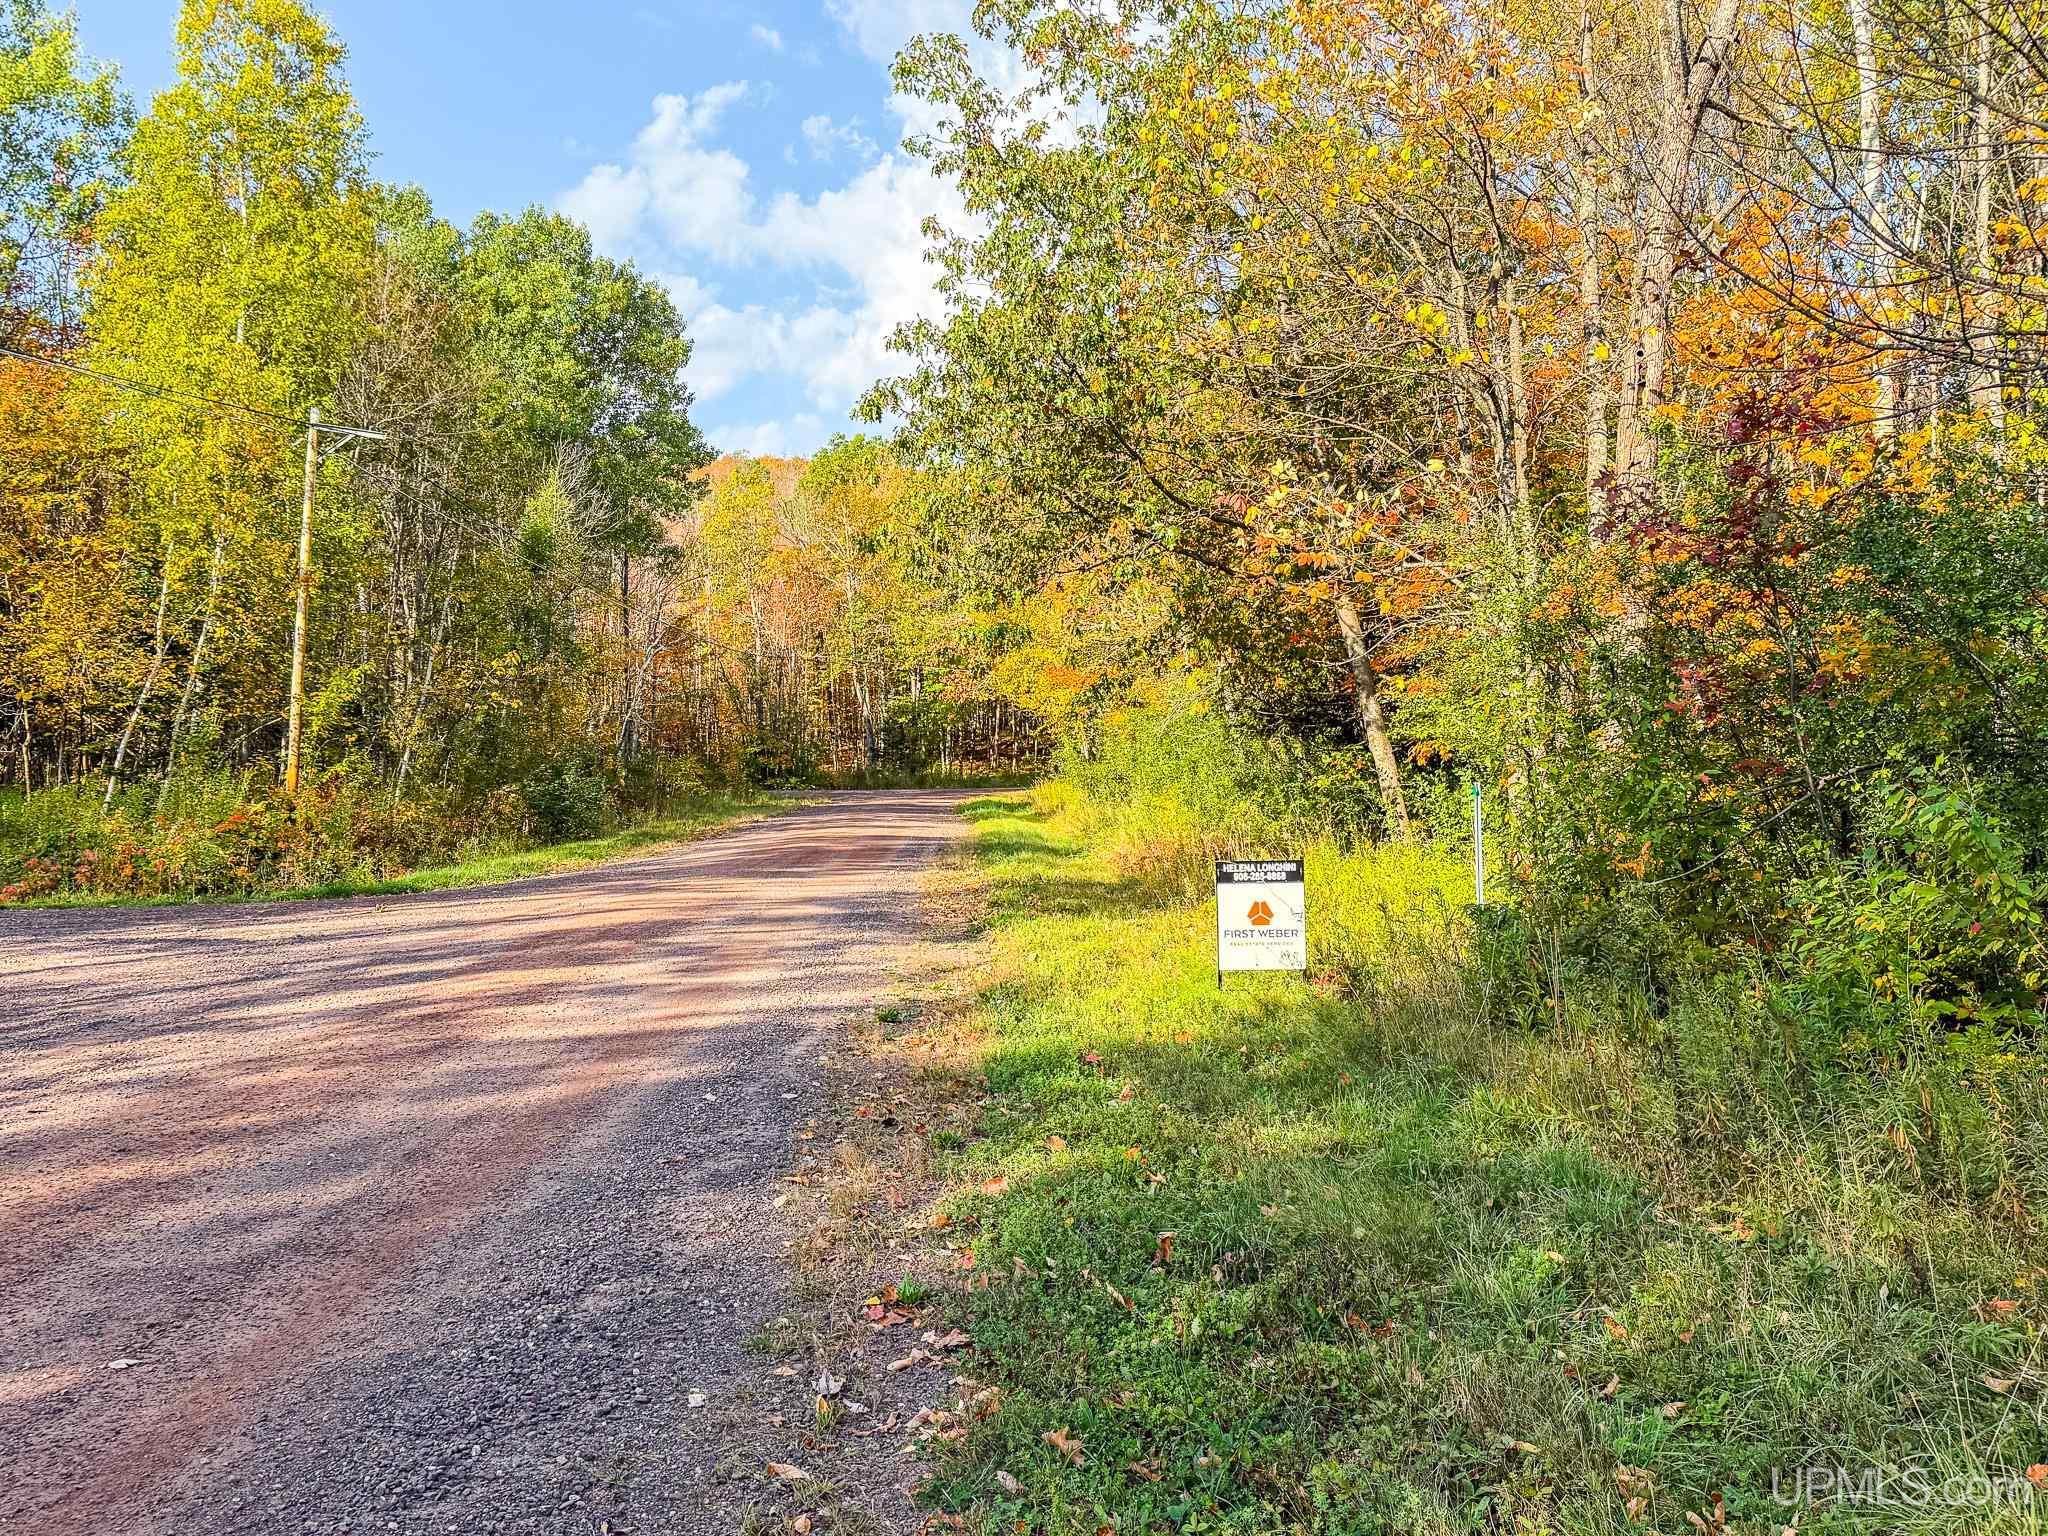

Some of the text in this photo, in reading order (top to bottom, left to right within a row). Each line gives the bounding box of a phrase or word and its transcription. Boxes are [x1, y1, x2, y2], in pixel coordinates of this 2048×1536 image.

[1223, 863, 1257, 872] HELENA
[1224, 929, 1299, 939] FIRST WEBER
